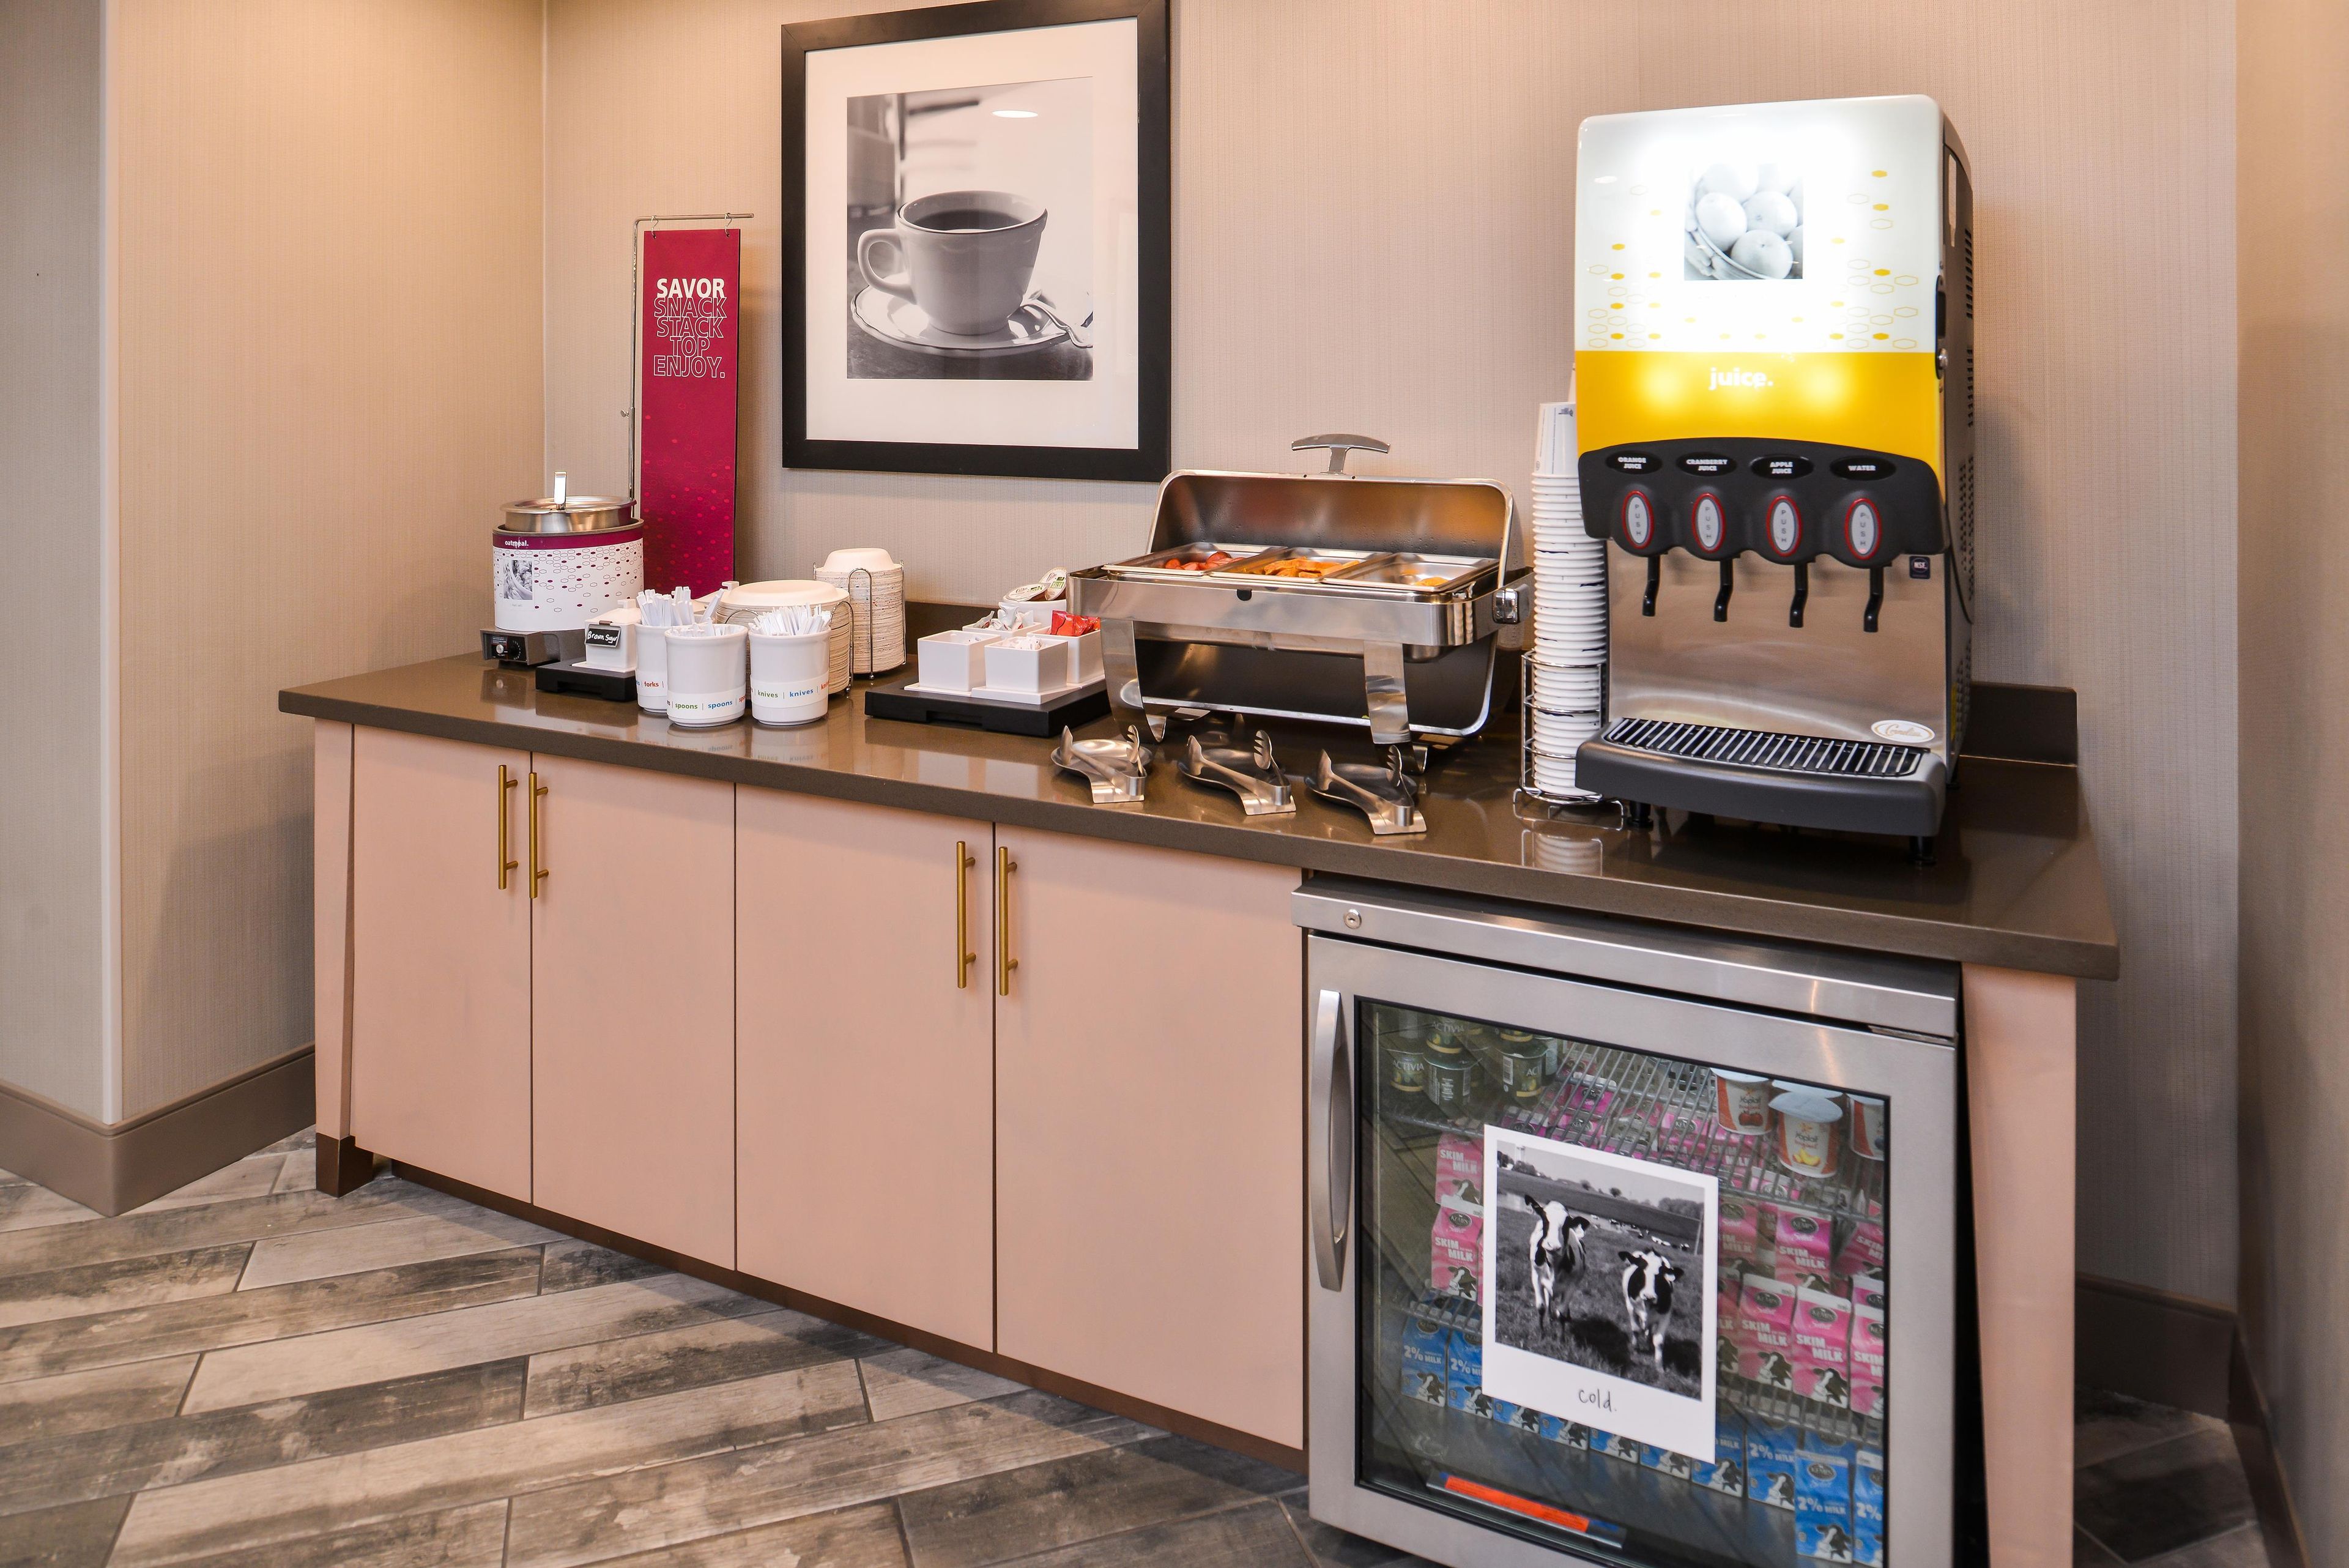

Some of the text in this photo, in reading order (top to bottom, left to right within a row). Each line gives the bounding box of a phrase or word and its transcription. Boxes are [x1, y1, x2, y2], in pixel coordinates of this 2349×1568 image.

[656, 278, 725, 299] SAVOR
[653, 297, 727, 318] SNACK
[656, 316, 724, 338] STACK
[669, 336, 710, 357] TOP
[653, 355, 725, 378] ENJOY.
[1708, 366, 1774, 391] juice.
[587, 631, 604, 640] Brown
[757, 689, 778, 698] knives
[789, 688, 814, 697] knives
[708, 700, 733, 709] spoons
[1393, 1059, 1425, 1071] ACTIVIA
[1440, 1149, 1464, 1161] SKIM
[1452, 1161, 1477, 1174] MILK
[1435, 1236, 1459, 1249] SKIM
[1722, 1242, 1753, 1254] MILK
[1447, 1248, 1473, 1262] MILK
[1779, 1246, 1808, 1256] SKIM
[1795, 1256, 1826, 1269] MILK
[1742, 1320, 1770, 1333] SKIM
[1757, 1332, 1788, 1347] MILK
[1796, 1333, 1826, 1349] SKIM
[1403, 1345, 1442, 1365] 2% MILK
[1811, 1347, 1843, 1363] MILK
[1854, 1351, 1883, 1366] SKIM
[1450, 1358, 1471, 1374] 2%
[1578, 1388, 1617, 1412] cold.
[1749, 1443, 1773, 1460] 2%
[1798, 1496, 1846, 1515] 2% MILK
[1857, 1502, 1882, 1522] 2%
